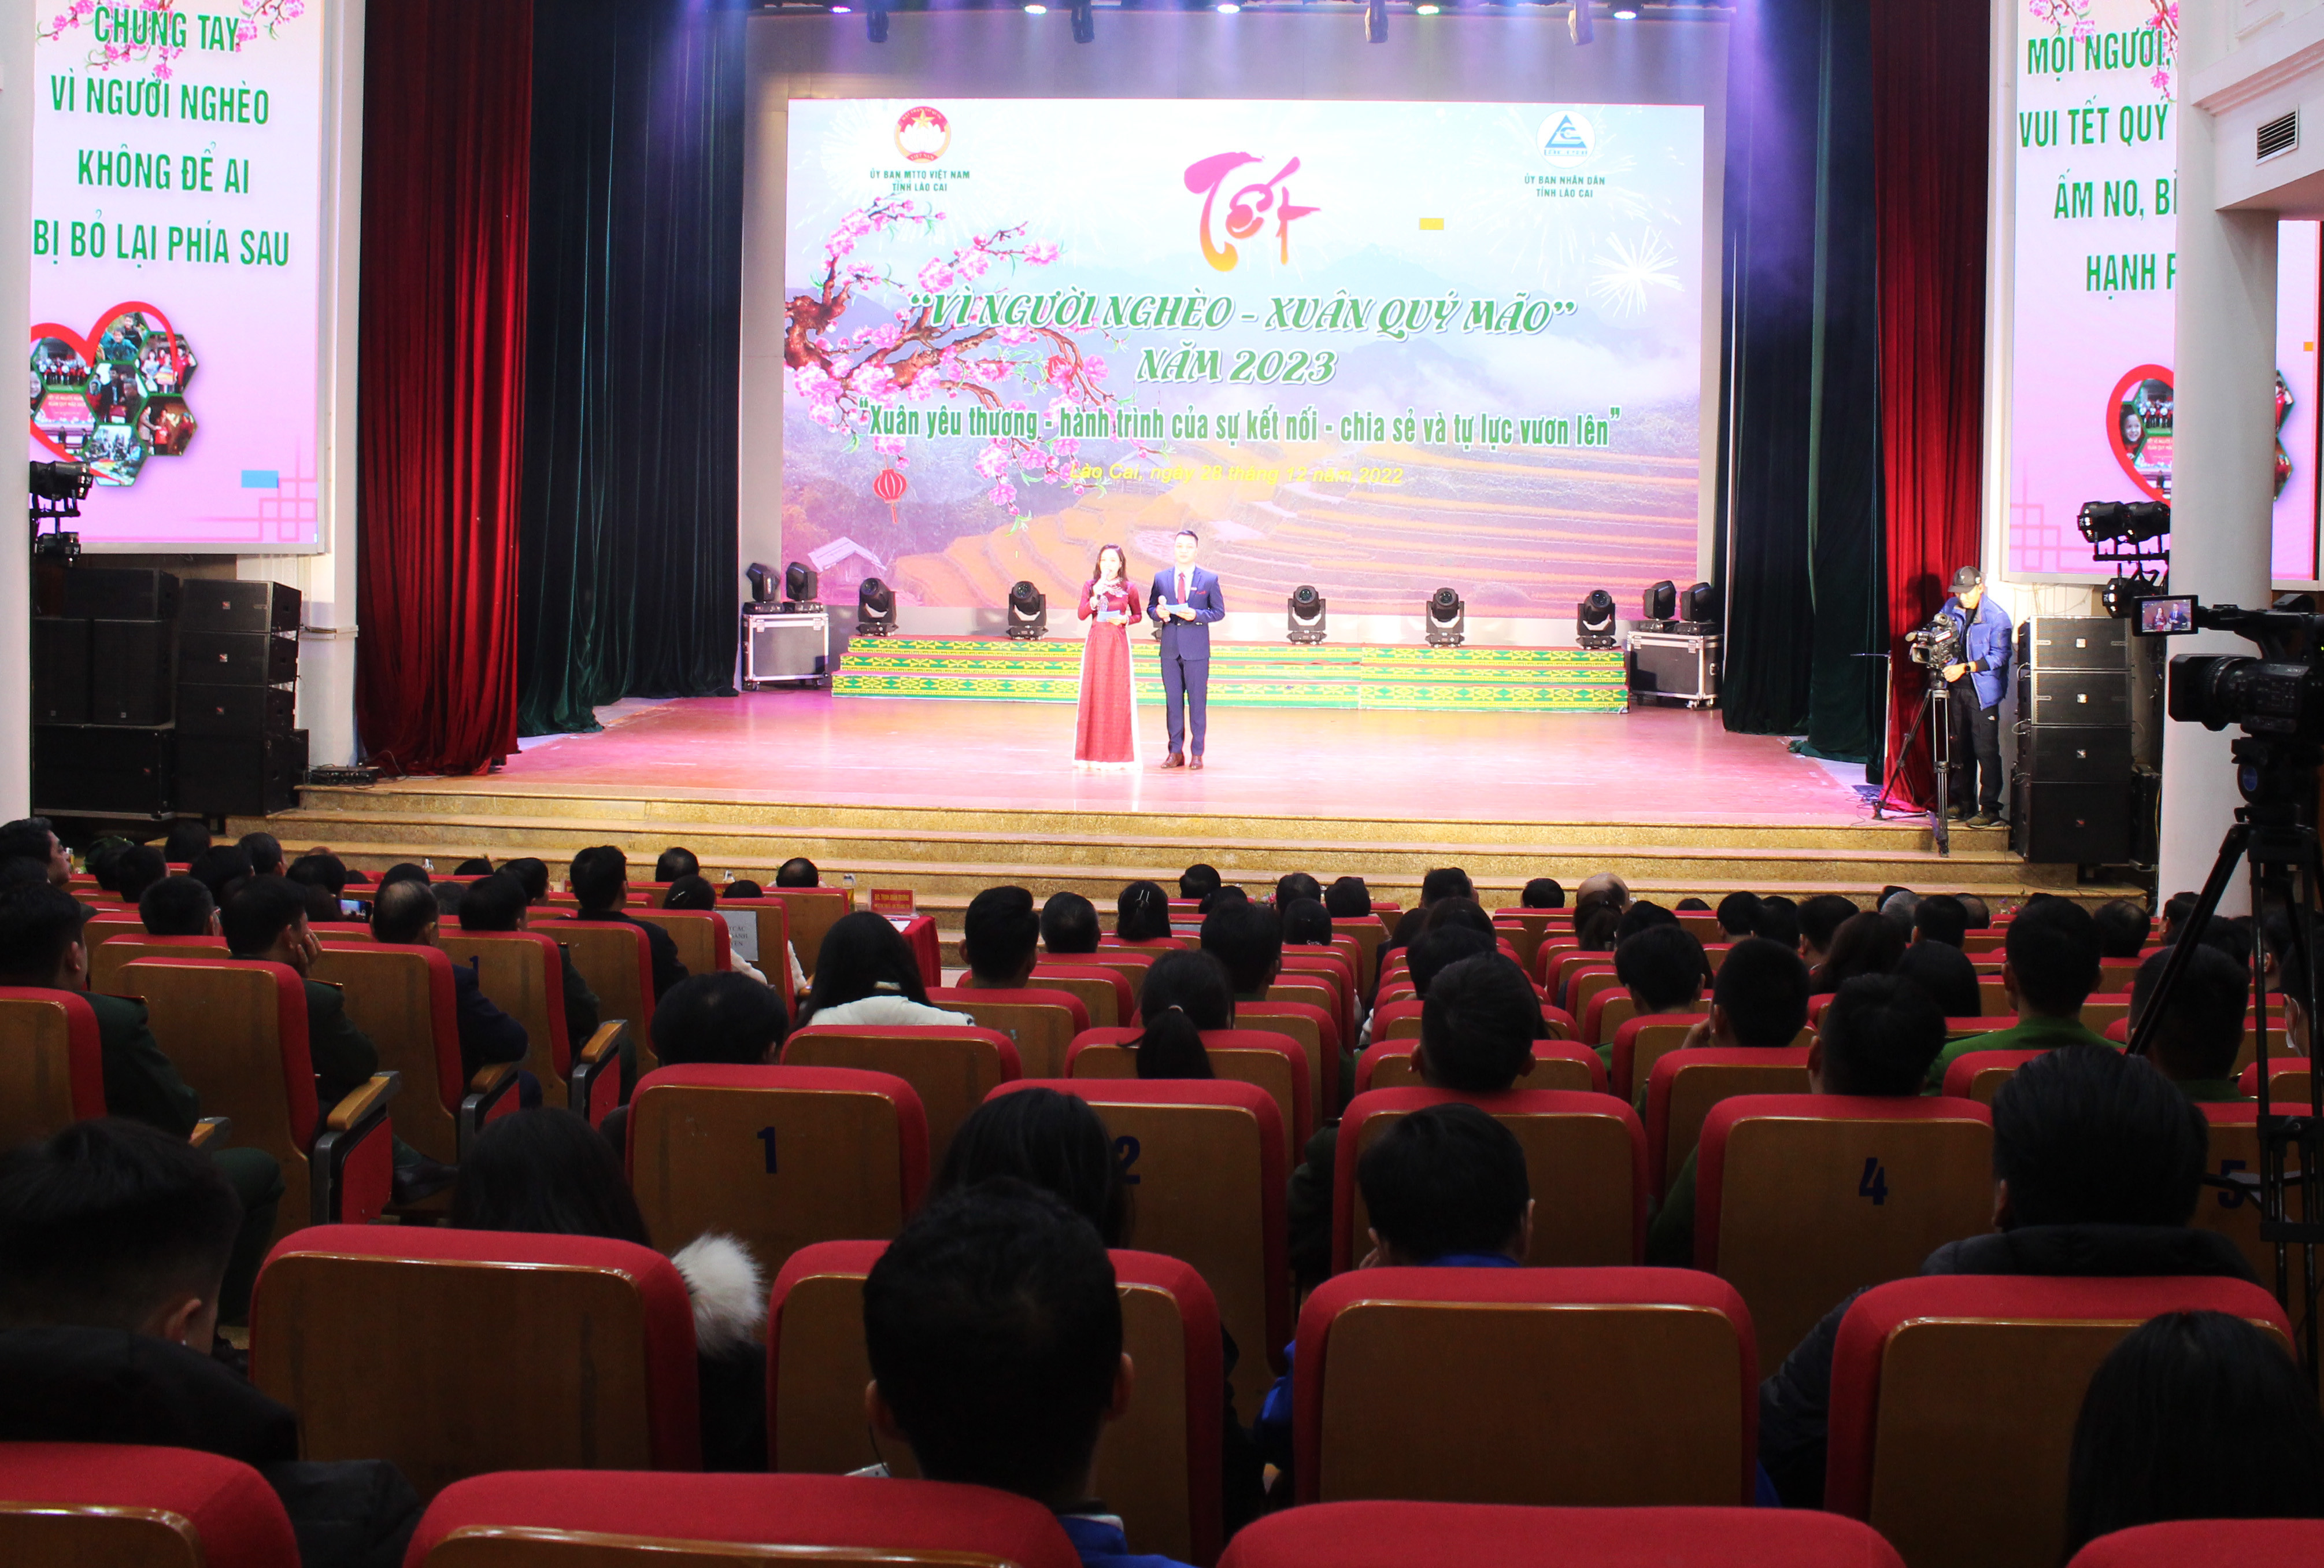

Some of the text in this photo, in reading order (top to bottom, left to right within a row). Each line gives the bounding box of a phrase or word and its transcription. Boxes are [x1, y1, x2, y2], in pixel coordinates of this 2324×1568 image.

[94, 6, 240, 51] CHUNG TAY
[2027, 36, 2074, 82] MỌI
[51, 67, 271, 124] VÌ NGƯỜI NGHÈO
[2019, 95, 2168, 147] VUI TẾT QUÝ
[77, 141, 250, 194] KHÔNG ĐỂ AI
[915, 181, 930, 191] LÀO
[930, 169, 947, 180] VIỆT
[951, 171, 969, 179] NAM
[1560, 175, 1584, 184] NHÂN
[1587, 175, 1605, 185] DÂN
[1560, 187, 1575, 197] LÀO
[2053, 169, 2093, 219] ẤM
[2104, 179, 2144, 221] NO,
[34, 209, 290, 268] BỊ BỎ LẠI PHÍA SAU
[2086, 253, 2155, 299] HẠNH
[980, 284, 1100, 327] NGƯỜI
[1102, 287, 1232, 328] NGHÈO
[1264, 288, 1374, 330] XUÂN
[1376, 290, 1460, 340] QUÝ
[1137, 340, 1336, 382] NĂM 2023
[927, 405, 961, 439] yêu
[969, 406, 1038, 440] thương
[1061, 406, 1109, 438] hành
[1116, 407, 1165, 439] trình
[1171, 406, 1208, 439] của
[1216, 410, 1241, 446] sự
[1246, 404, 1278, 441] kết
[1285, 406, 1318, 441] nối
[1340, 411, 1385, 442] chia
[1392, 407, 1416, 443] sẻ
[1423, 416, 1445, 444] và
[1454, 417, 1473, 452] tự
[1481, 412, 1512, 452] lực
[1520, 418, 1568, 446] vươn
[1070, 463, 1404, 485] Lào Cai, ngày 28 tháng 12 năm 2022
[757, 1126, 777, 1174] 1
[1115, 1136, 1141, 1184] 2
[1859, 1157, 1888, 1205] 4
